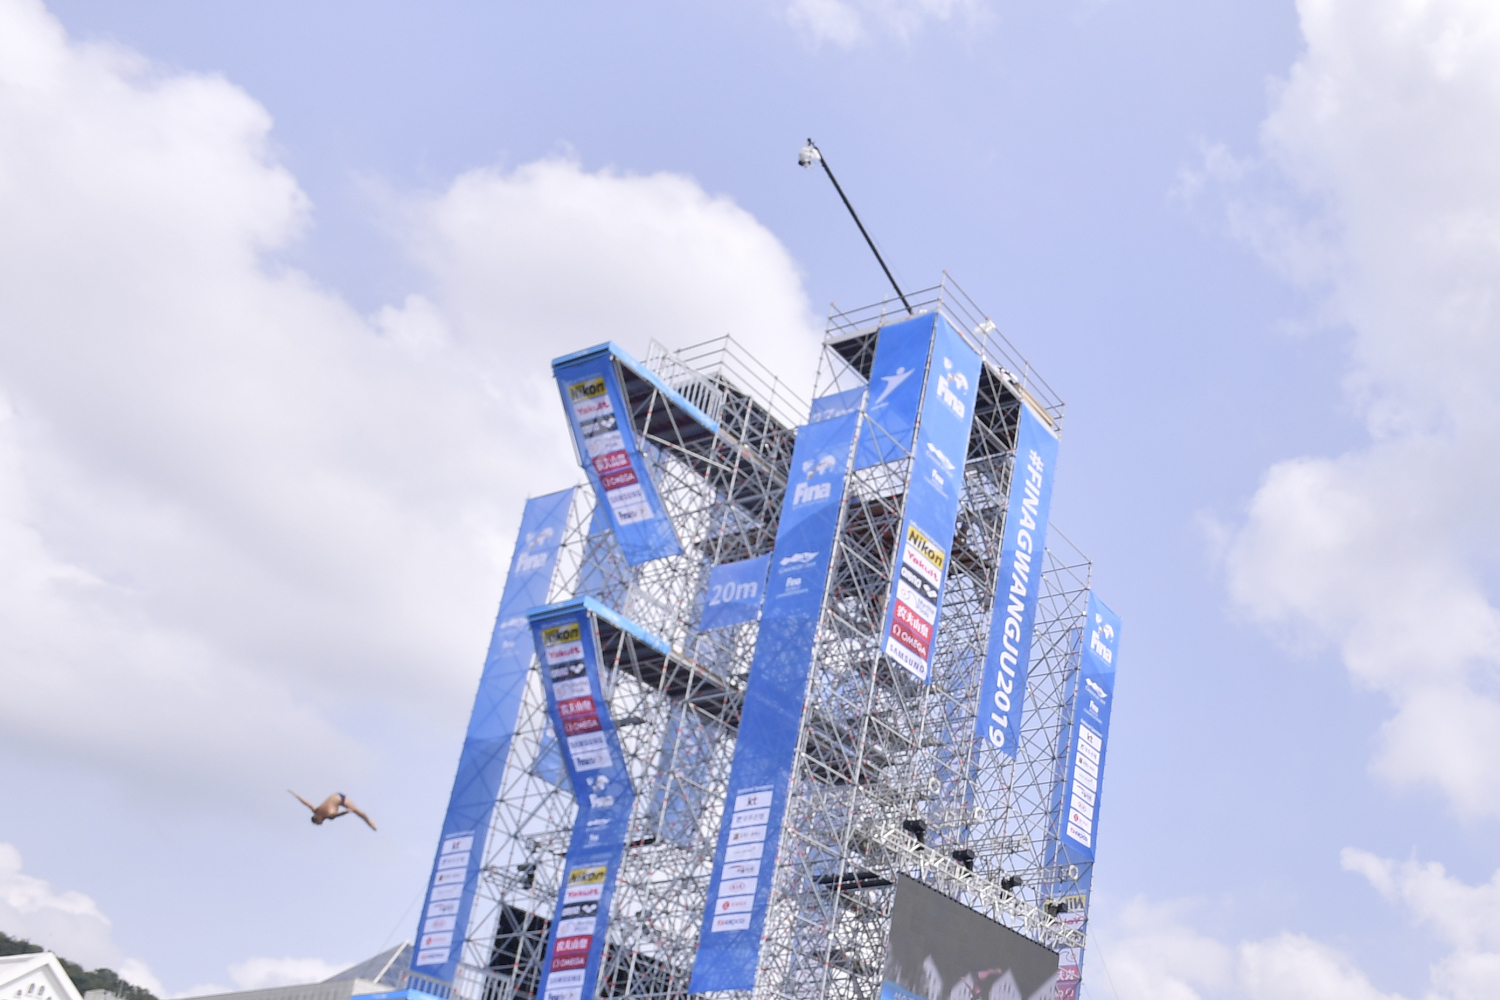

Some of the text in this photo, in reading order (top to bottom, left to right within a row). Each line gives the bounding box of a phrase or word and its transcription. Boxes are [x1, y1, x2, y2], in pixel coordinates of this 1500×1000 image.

[793, 482, 832, 505] Fina
[908, 530, 943, 567] Nikon
[908, 551, 939, 582] Yakult
[709, 581, 758, 606] 20m
[988, 449, 1045, 748] #FINAGWANGJU2019
[889, 642, 925, 673] SAMSUNG
[901, 631, 927, 657] OMEGA
[1090, 630, 1112, 664] Fina
